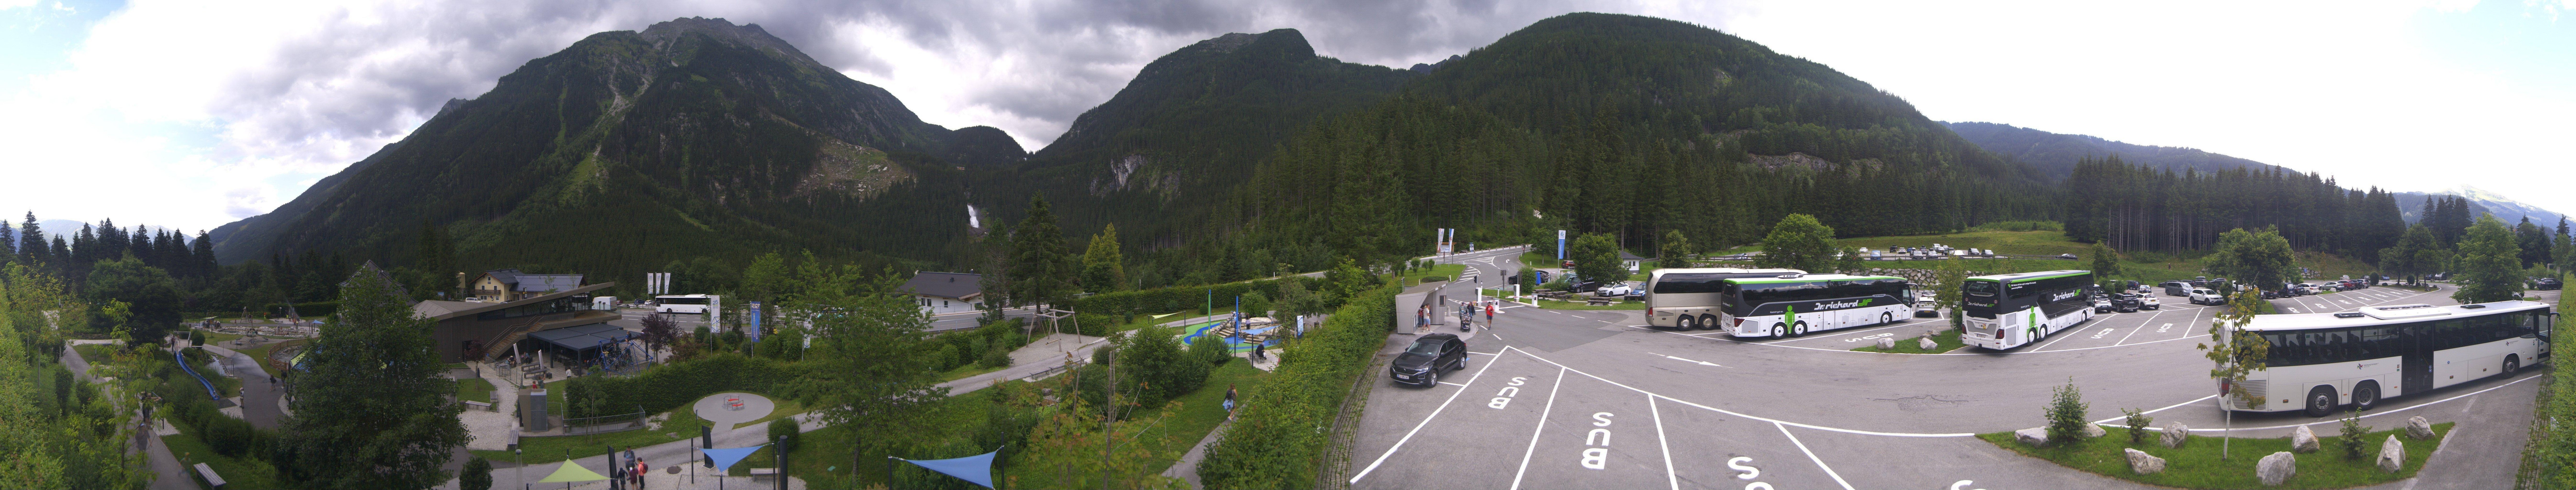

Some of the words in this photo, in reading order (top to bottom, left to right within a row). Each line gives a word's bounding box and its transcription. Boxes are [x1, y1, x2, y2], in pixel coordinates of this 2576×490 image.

[2058, 290, 2074, 300] richard
[2156, 323, 2173, 332] BUS
[1845, 333, 1894, 342] BUS
[2091, 328, 2114, 338] BUS
[1488, 377, 1528, 409] BUS
[1581, 412, 1614, 470] BUS
